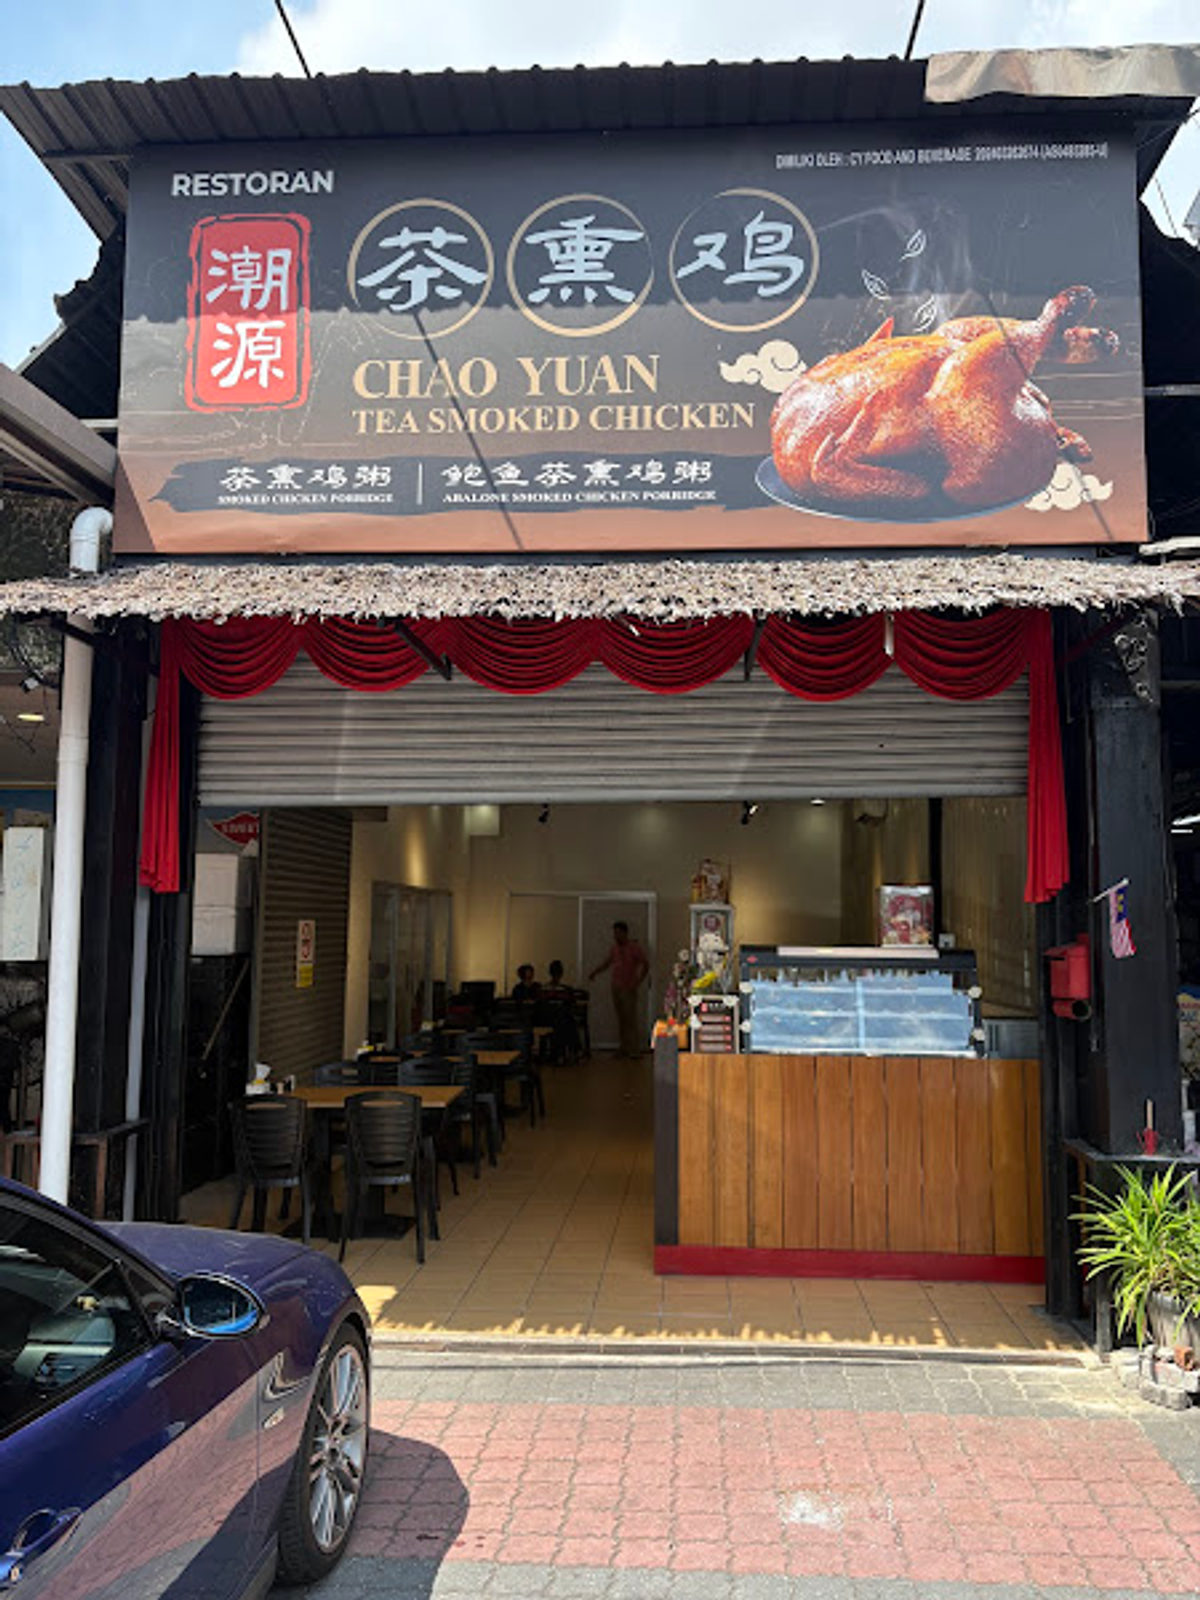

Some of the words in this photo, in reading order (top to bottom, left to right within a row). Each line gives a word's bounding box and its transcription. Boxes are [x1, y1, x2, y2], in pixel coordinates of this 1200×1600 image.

[893, 148, 916, 164] AND
[171, 170, 335, 197] RESTORAN
[206, 245, 292, 389] 潮源
[352, 357, 498, 399] CHAO
[515, 354, 660, 397] YUAN
[351, 407, 421, 434] TEA
[426, 405, 580, 434] SMOKED
[588, 402, 756, 432] CHICKEN
[218, 494, 271, 505] SMOKED
[272, 493, 328, 504] CHICKEN
[330, 492, 393, 503] PORRIDGE
[441, 493, 509, 503] ABALONE
[511, 493, 573, 503] SMOKED
[575, 491, 640, 502] CHICKEN
[642, 490, 717, 500] PORRIDGE
